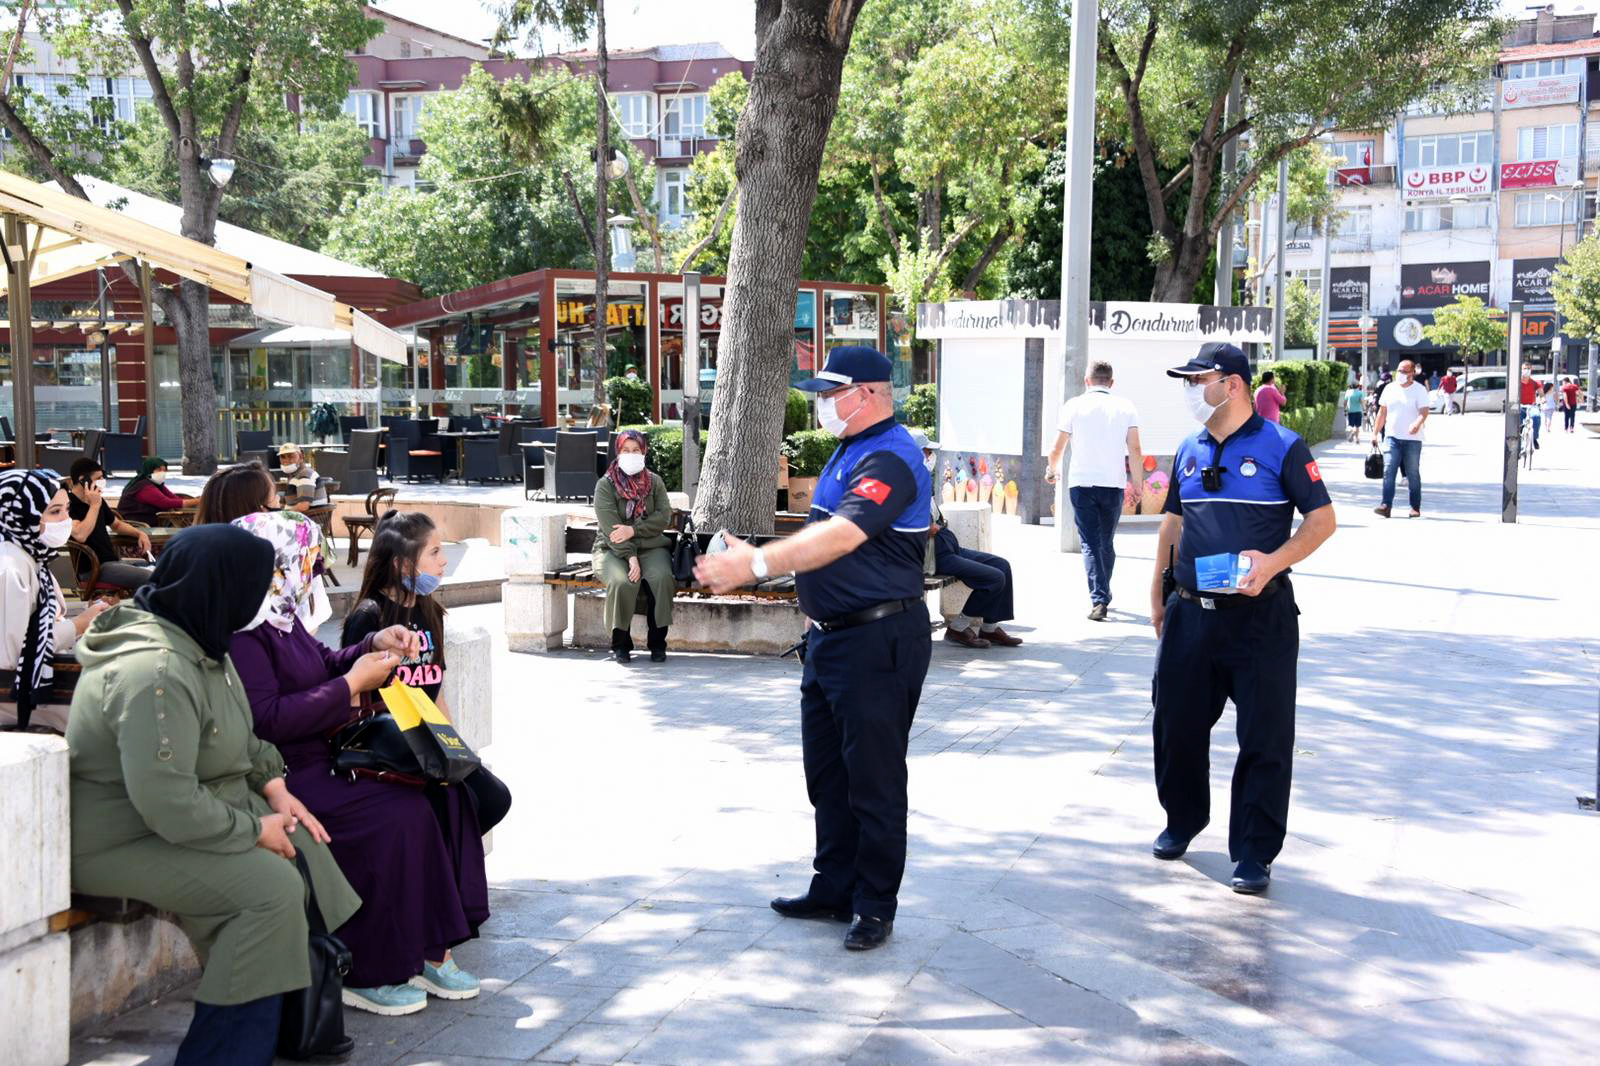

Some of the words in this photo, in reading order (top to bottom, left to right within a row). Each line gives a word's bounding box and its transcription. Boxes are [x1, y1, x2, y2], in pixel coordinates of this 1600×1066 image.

[1429, 171, 1465, 184] BBP
[1407, 189, 1434, 197] KONYA
[1418, 284, 1450, 295] ACAR
[1452, 283, 1489, 294] HOME
[1516, 279, 1543, 287] ACAR
[1110, 310, 1195, 335] Dondurma
[391, 664, 442, 686] DAD
